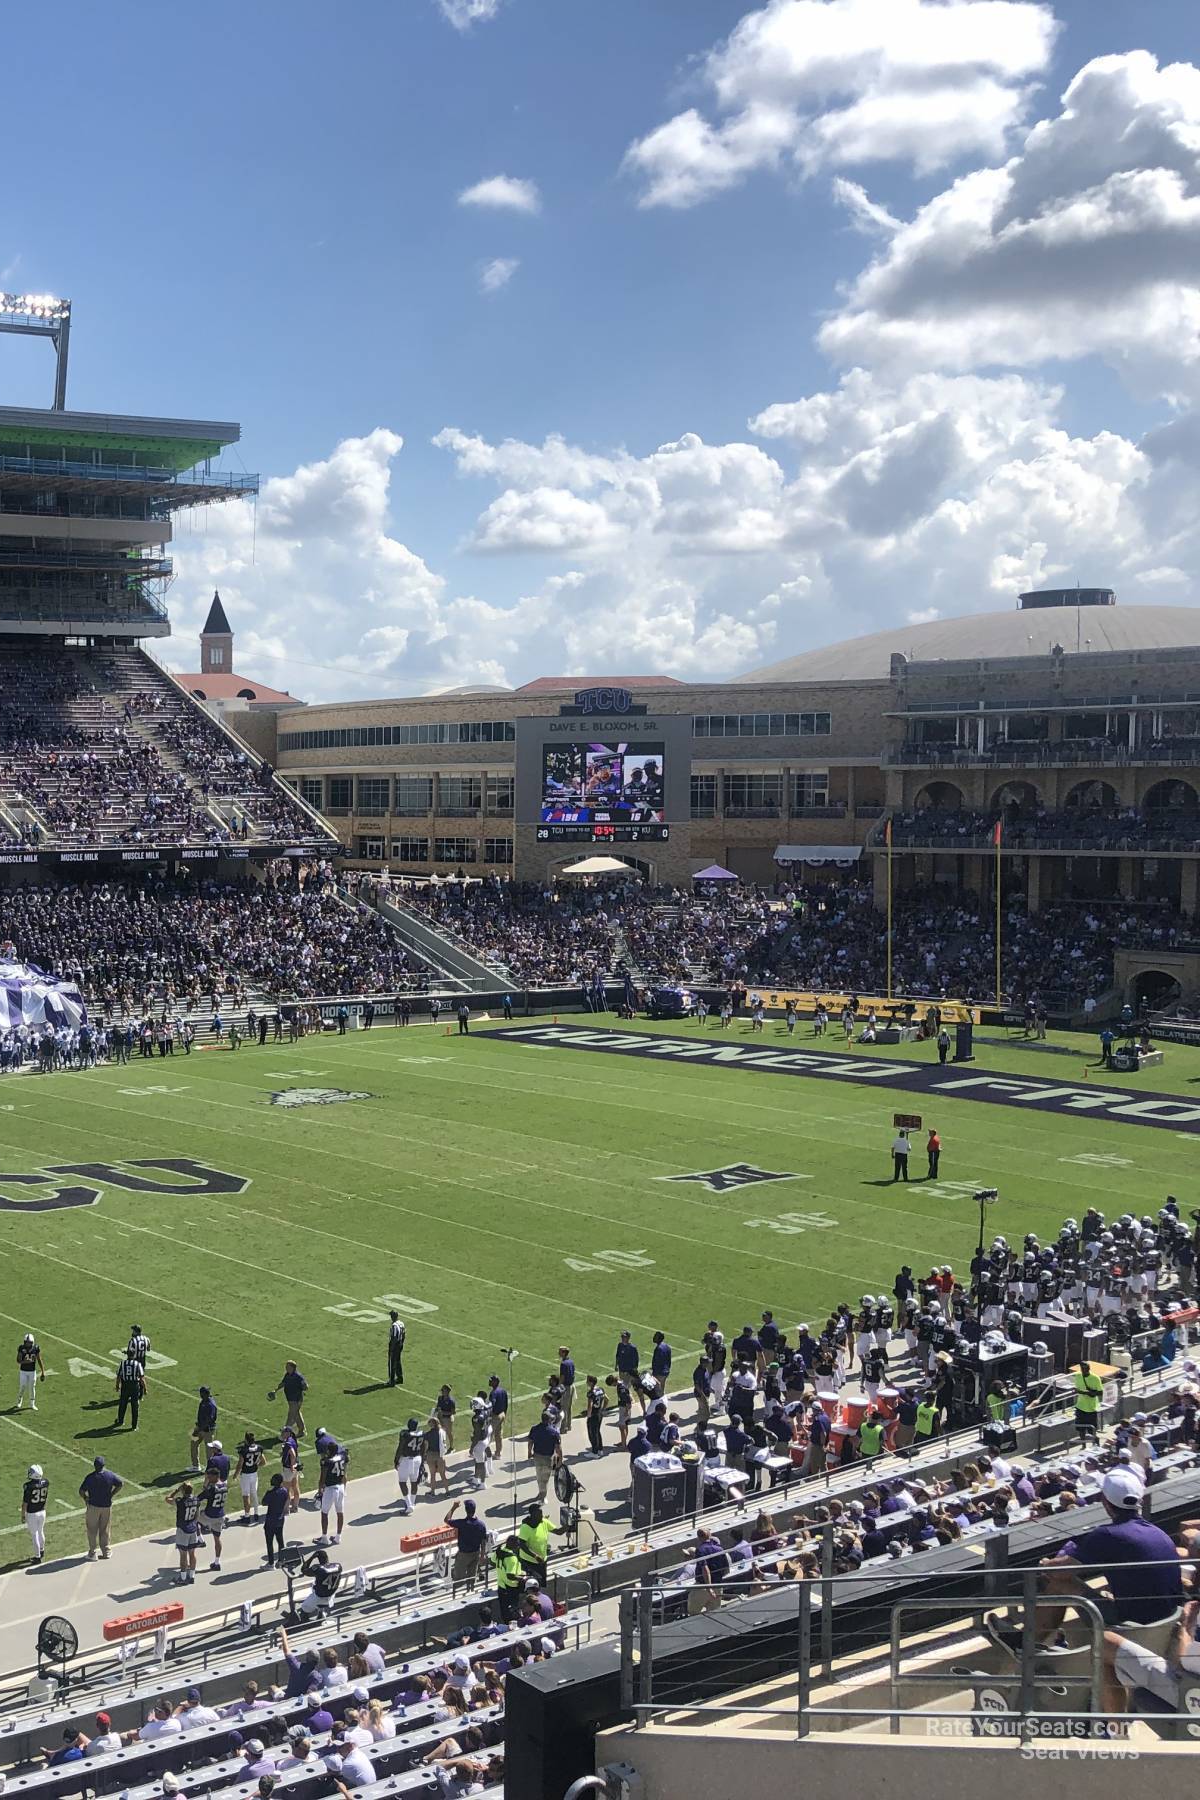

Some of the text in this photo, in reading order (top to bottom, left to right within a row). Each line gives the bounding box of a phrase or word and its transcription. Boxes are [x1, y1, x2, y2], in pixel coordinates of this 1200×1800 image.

[579, 689, 631, 714] TCU
[550, 722, 577, 732] DAVE
[537, 829, 549, 838] 28
[594, 826, 615, 835] 10:54
[632, 832, 638, 840] 2
[662, 829, 668, 838] 0
[0, 855, 23, 863] MUSCLE
[60, 853, 99, 862] MUSCLE MILK
[122, 852, 145, 860] MUSCLE
[182, 850, 204, 858] MUSCLE
[499, 1027, 923, 1077] HORNED
[743, 1211, 839, 1235] 30
[562, 1249, 657, 1274] 40
[322, 1293, 439, 1324] 50
[138, 1340, 145, 1351] C
[126, 1365, 133, 1376] B
[865, 1363, 872, 1377] 6
[407, 1437, 424, 1452] 42
[245, 1452, 262, 1468] 37
[30, 1486, 48, 1504] 39
[661, 1487, 678, 1498] TCU
[184, 1505, 197, 1521] 18
[420, 1530, 457, 1546] GATORADE
[125, 1613, 169, 1632] GATORADE
[983, 1697, 1006, 1712] TCU
